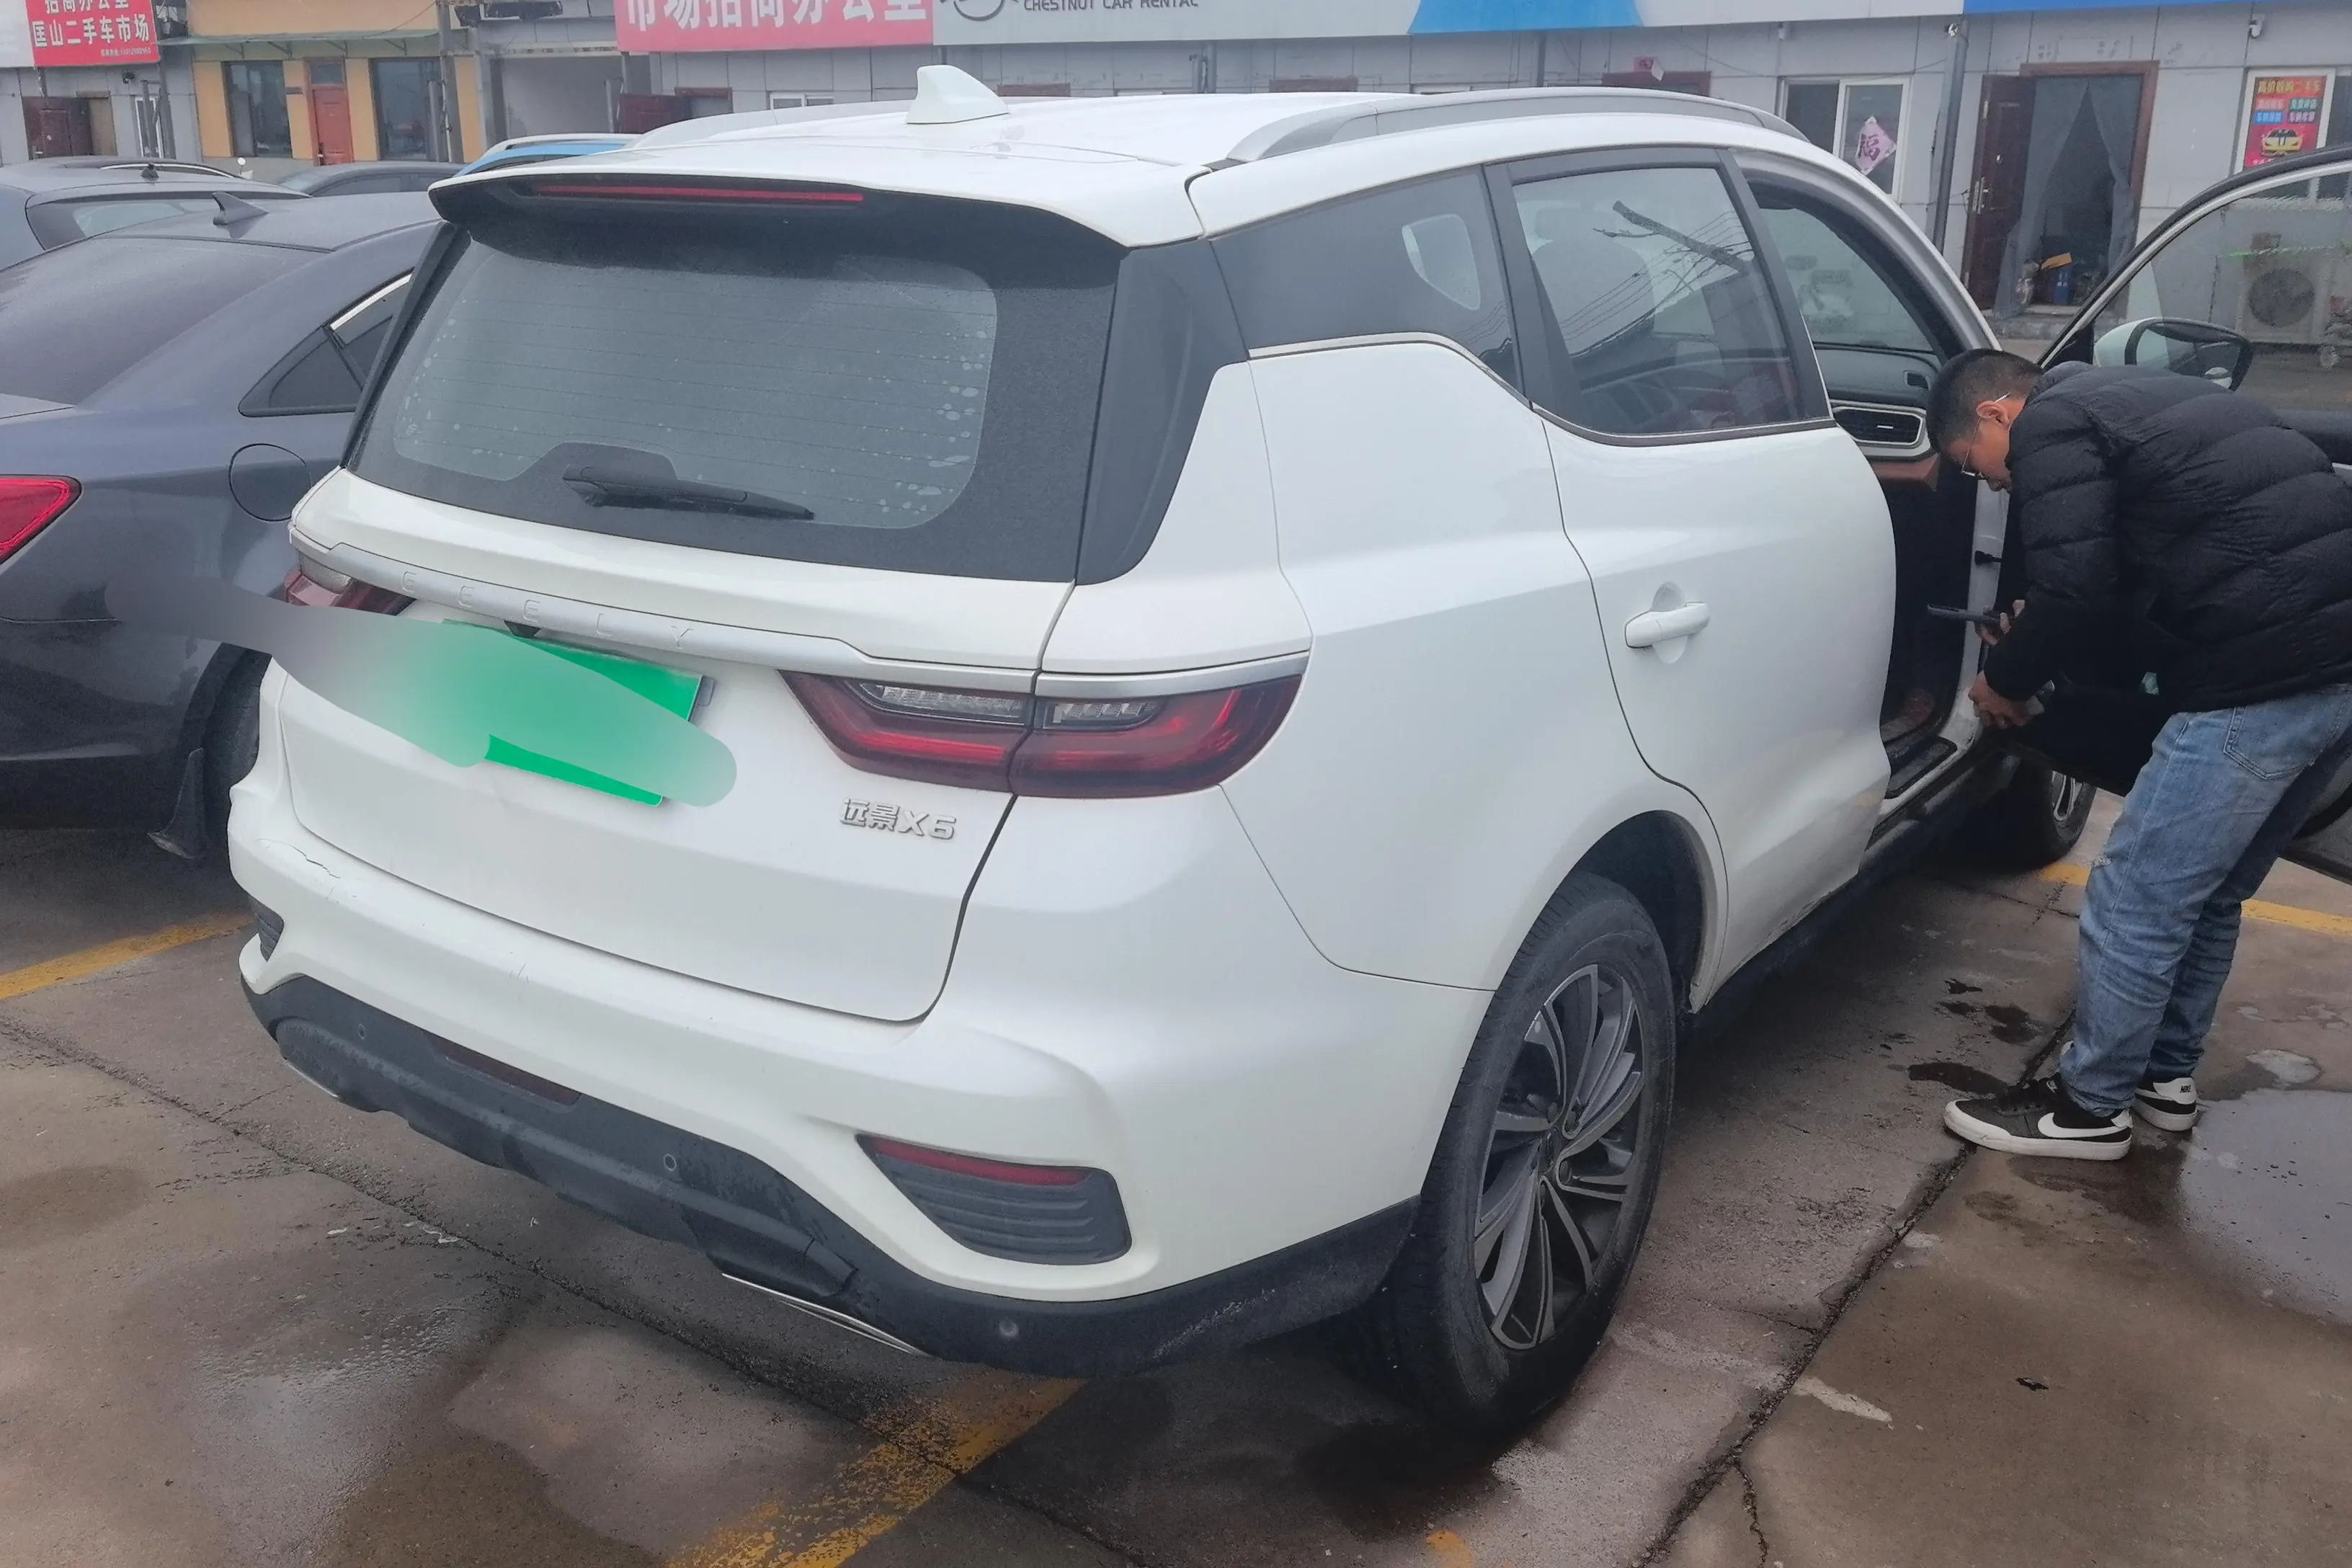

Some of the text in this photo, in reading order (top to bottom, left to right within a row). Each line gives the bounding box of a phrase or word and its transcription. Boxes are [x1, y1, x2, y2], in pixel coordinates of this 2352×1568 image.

[1103, 0, 1133, 9] CAR
[32, 13, 150, 48] 匡山二手车市场
[401, 570, 694, 650] GEELY
